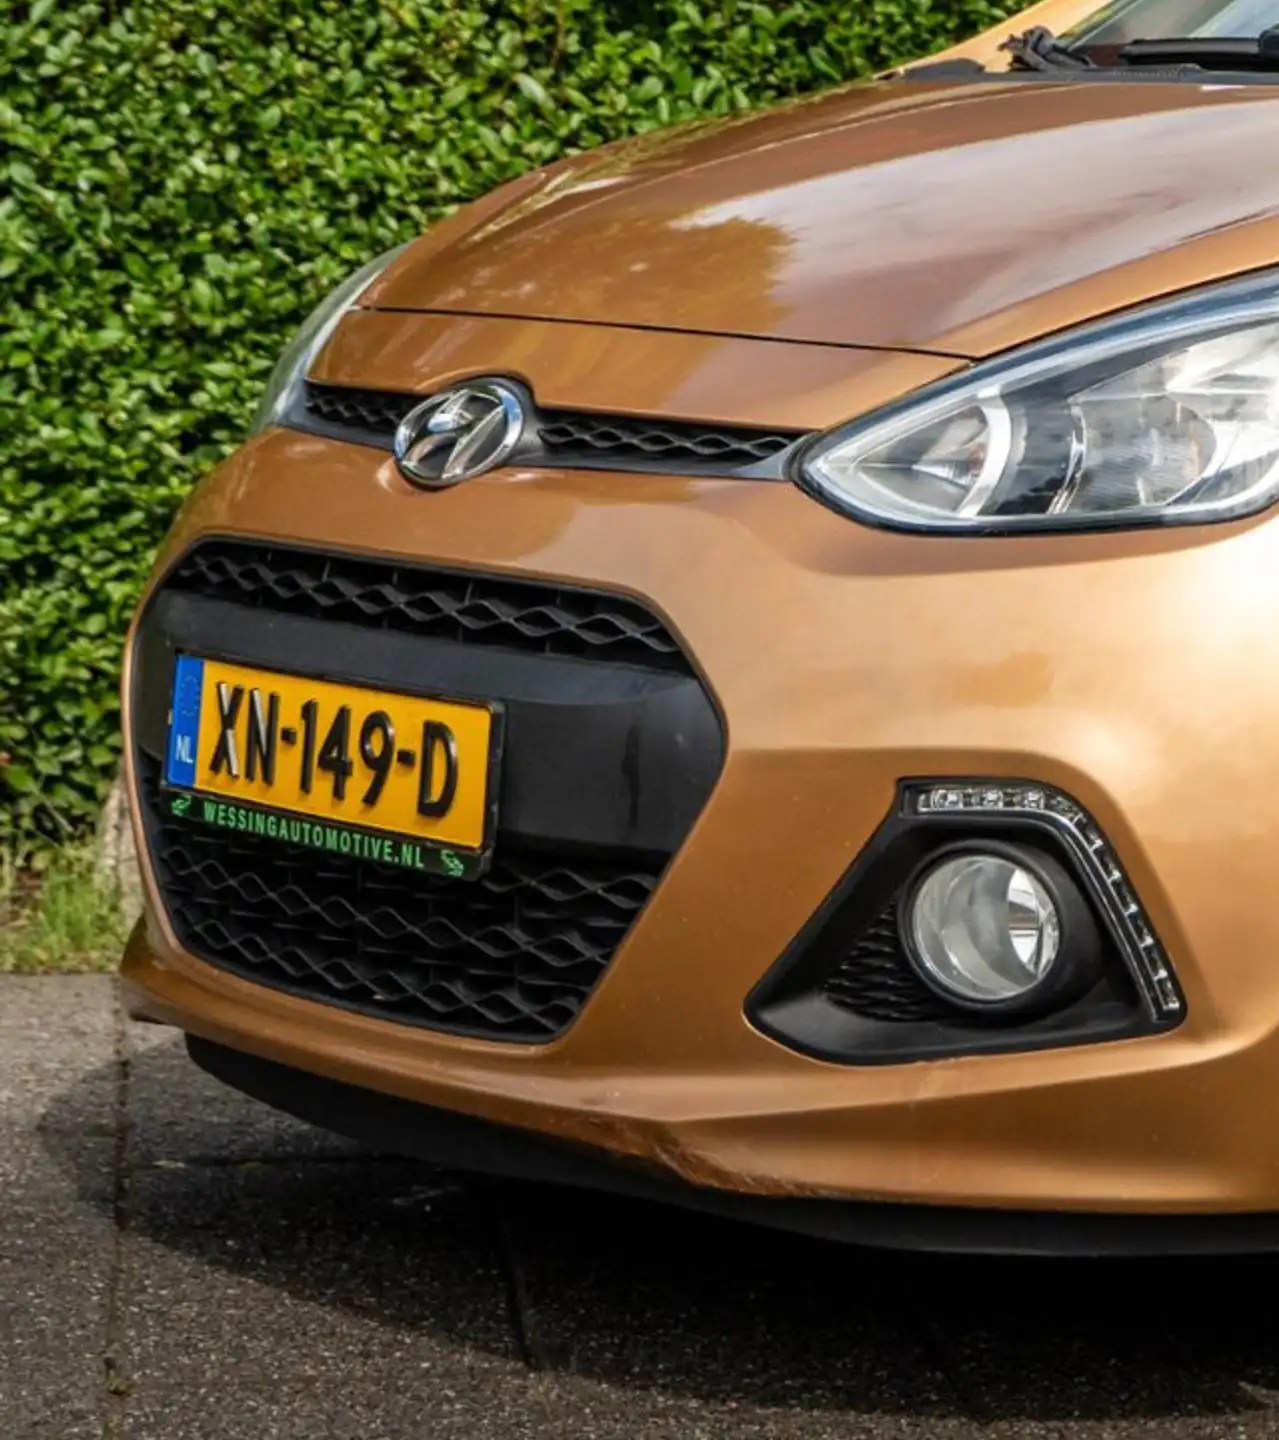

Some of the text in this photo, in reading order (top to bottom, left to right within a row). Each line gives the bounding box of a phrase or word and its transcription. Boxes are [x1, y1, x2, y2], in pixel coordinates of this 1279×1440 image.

[174, 732, 194, 765] NL
[208, 680, 459, 818] XN-149-D
[203, 800, 425, 869] WESSINGAUTOMOTIVE.NL
